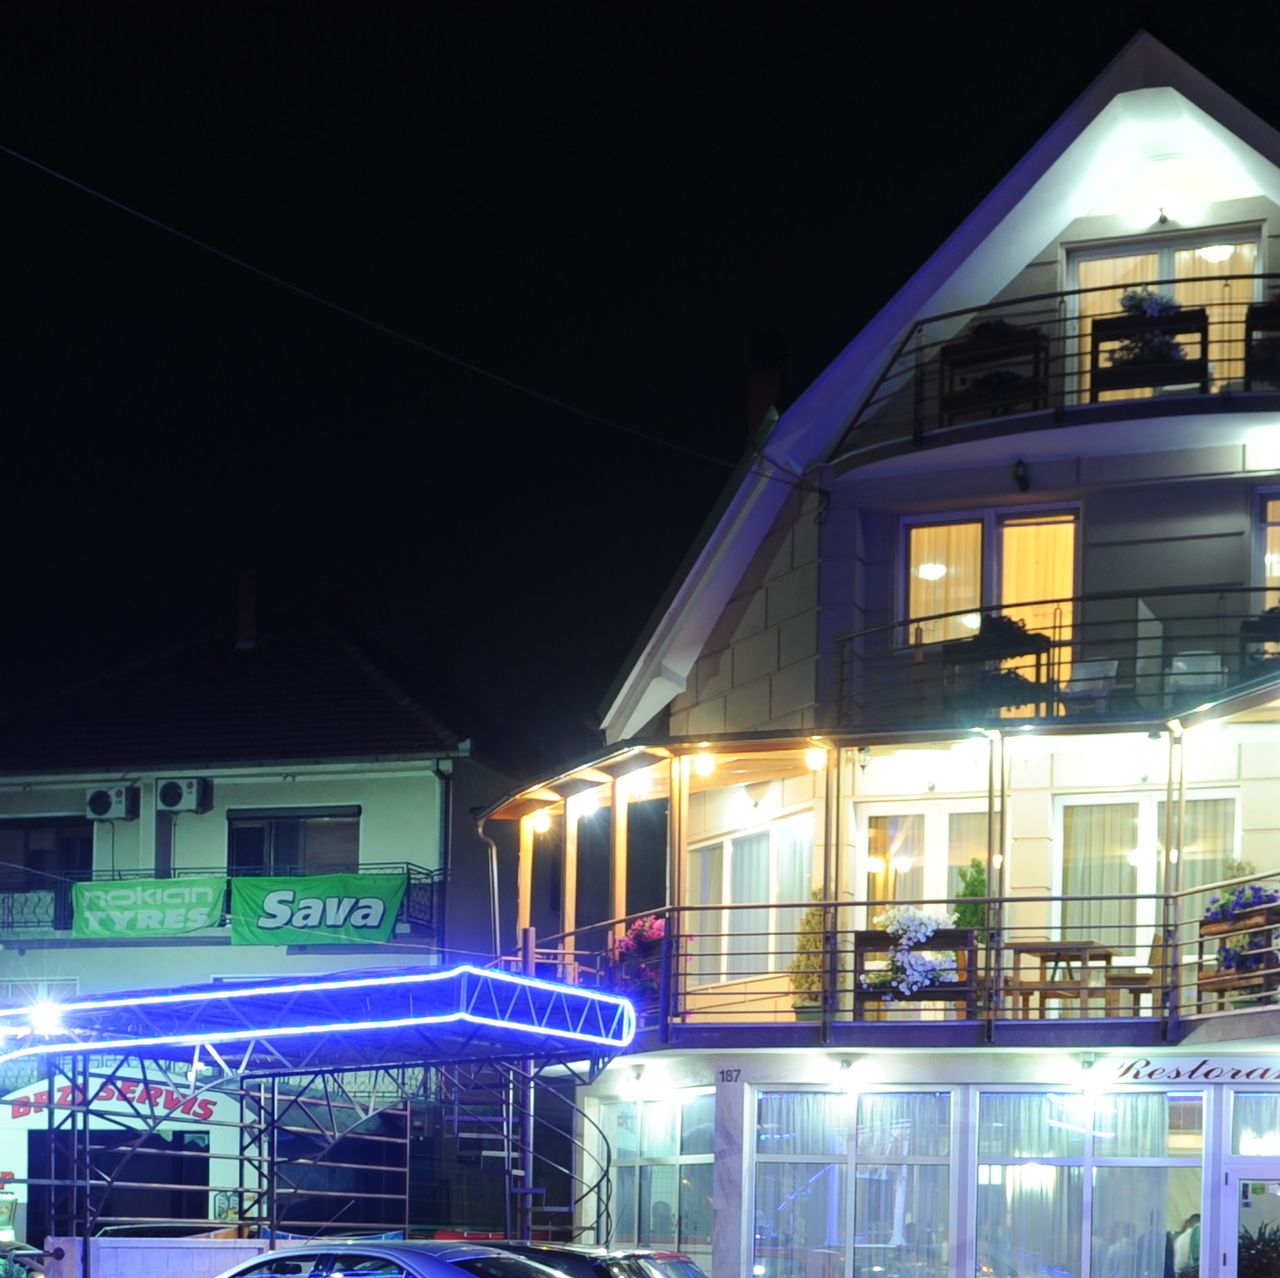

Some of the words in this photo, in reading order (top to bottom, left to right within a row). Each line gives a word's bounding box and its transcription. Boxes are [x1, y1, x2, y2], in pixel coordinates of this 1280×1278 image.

[84, 907, 210, 930] TYRES
[258, 890, 385, 929] Sava
[718, 1069, 741, 1083] 187
[96, 1081, 217, 1120] SERVIS
